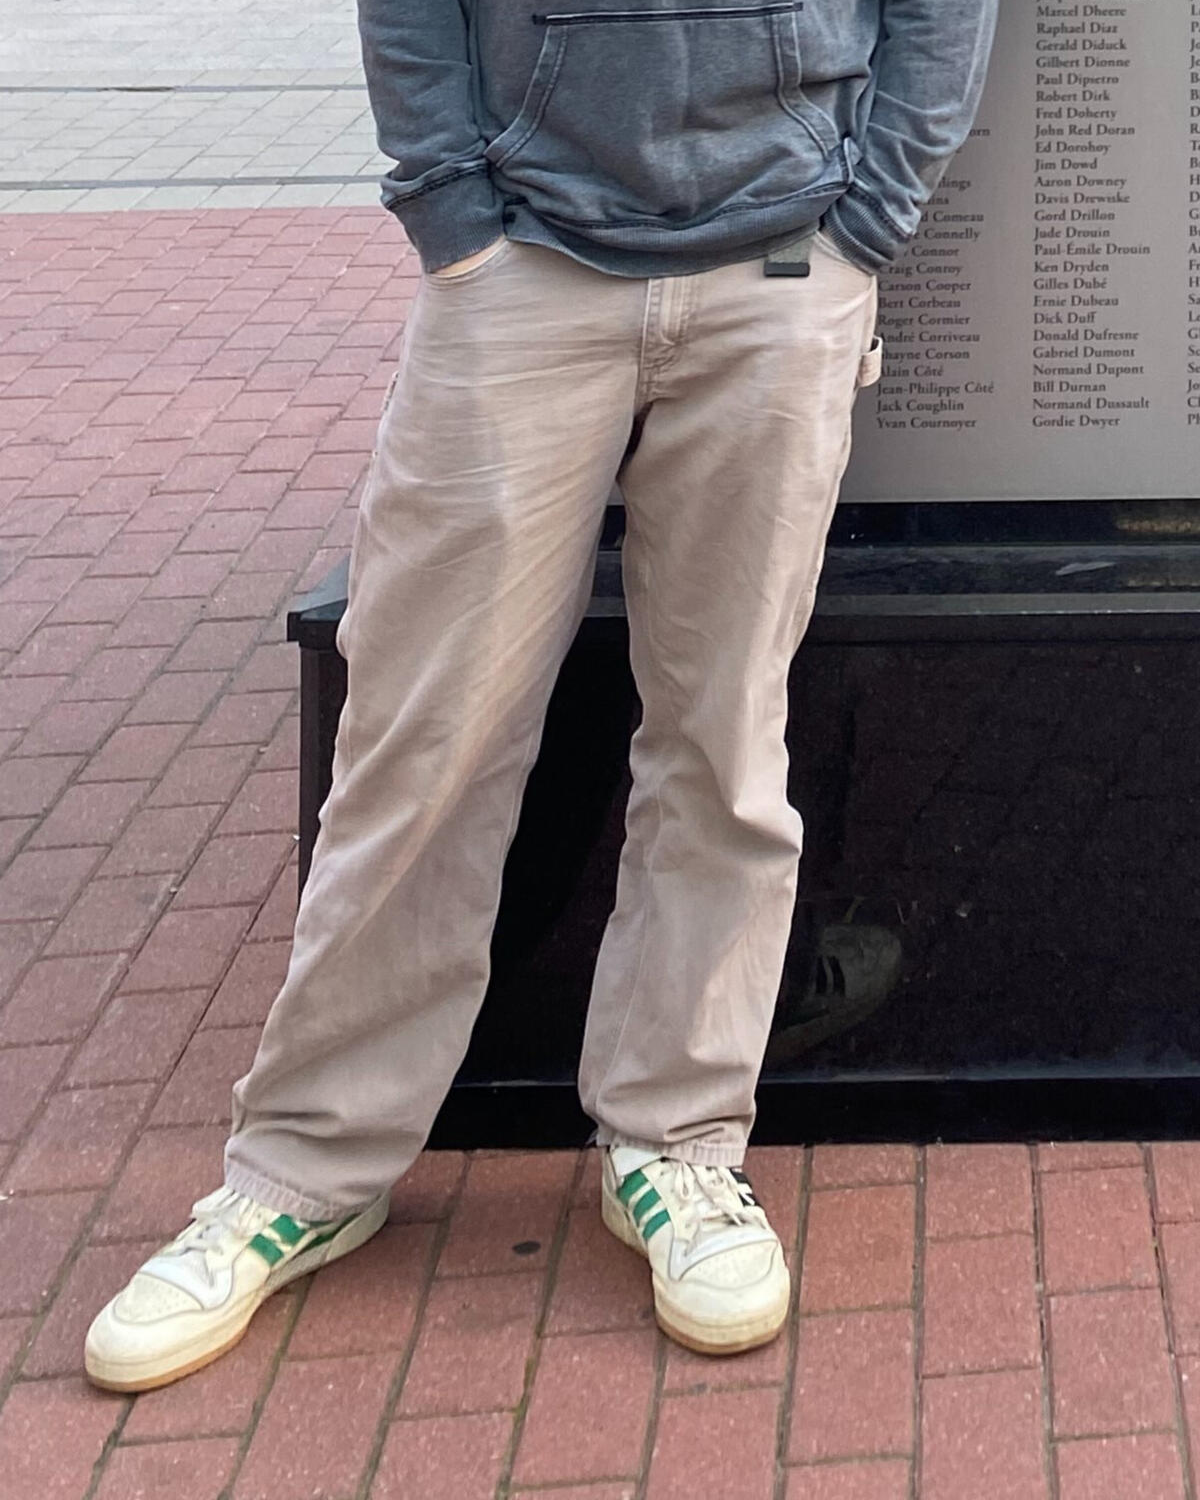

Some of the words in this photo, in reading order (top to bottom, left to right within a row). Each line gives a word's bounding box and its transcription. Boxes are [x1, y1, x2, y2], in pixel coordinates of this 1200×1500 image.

[1034, 260, 1059, 273] Ken
[1063, 259, 1110, 276] Dryden
[1033, 328, 1080, 342] Donald
[875, 399, 903, 415] Jack
[905, 398, 965, 415] Coughlin
